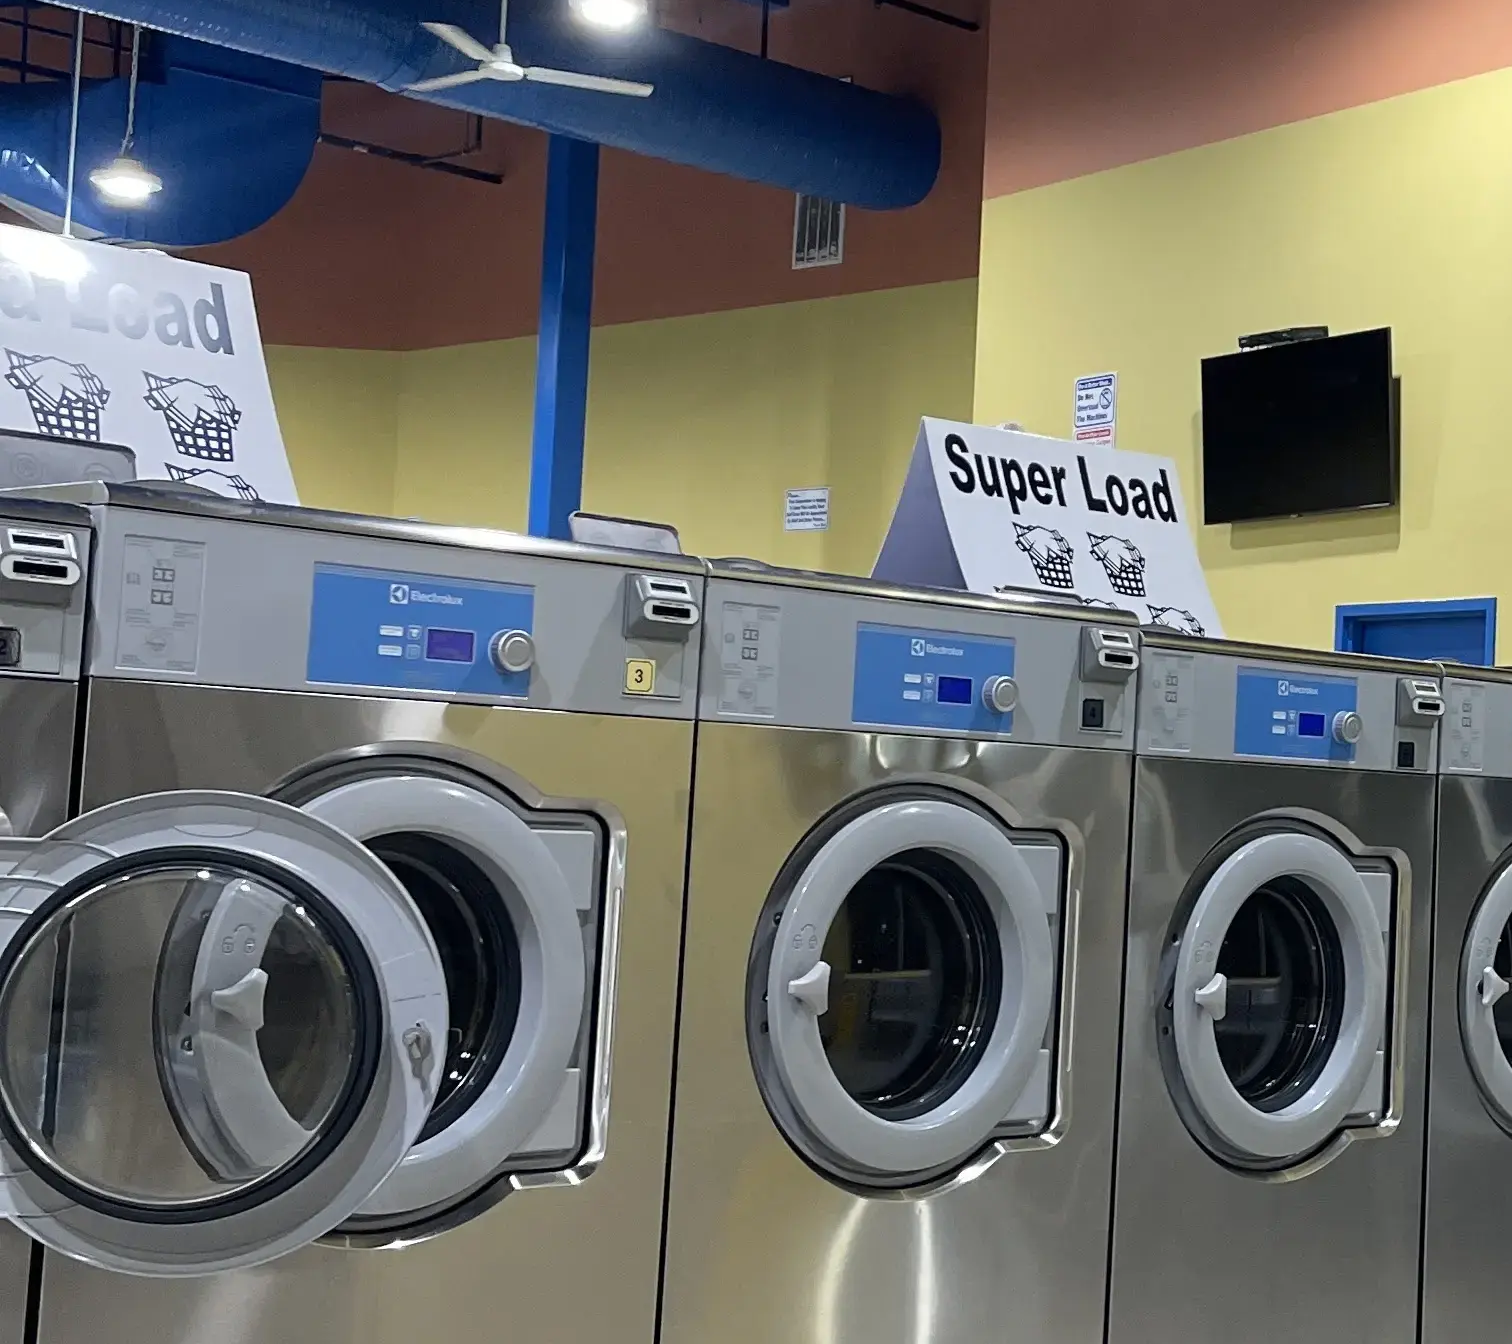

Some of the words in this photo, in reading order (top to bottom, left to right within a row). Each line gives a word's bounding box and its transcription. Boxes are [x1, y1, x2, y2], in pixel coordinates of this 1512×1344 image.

[944, 433, 1067, 515] Super
[1076, 455, 1178, 523] Load
[410, 590, 463, 606] Electrolux
[634, 668, 644, 684] 3
